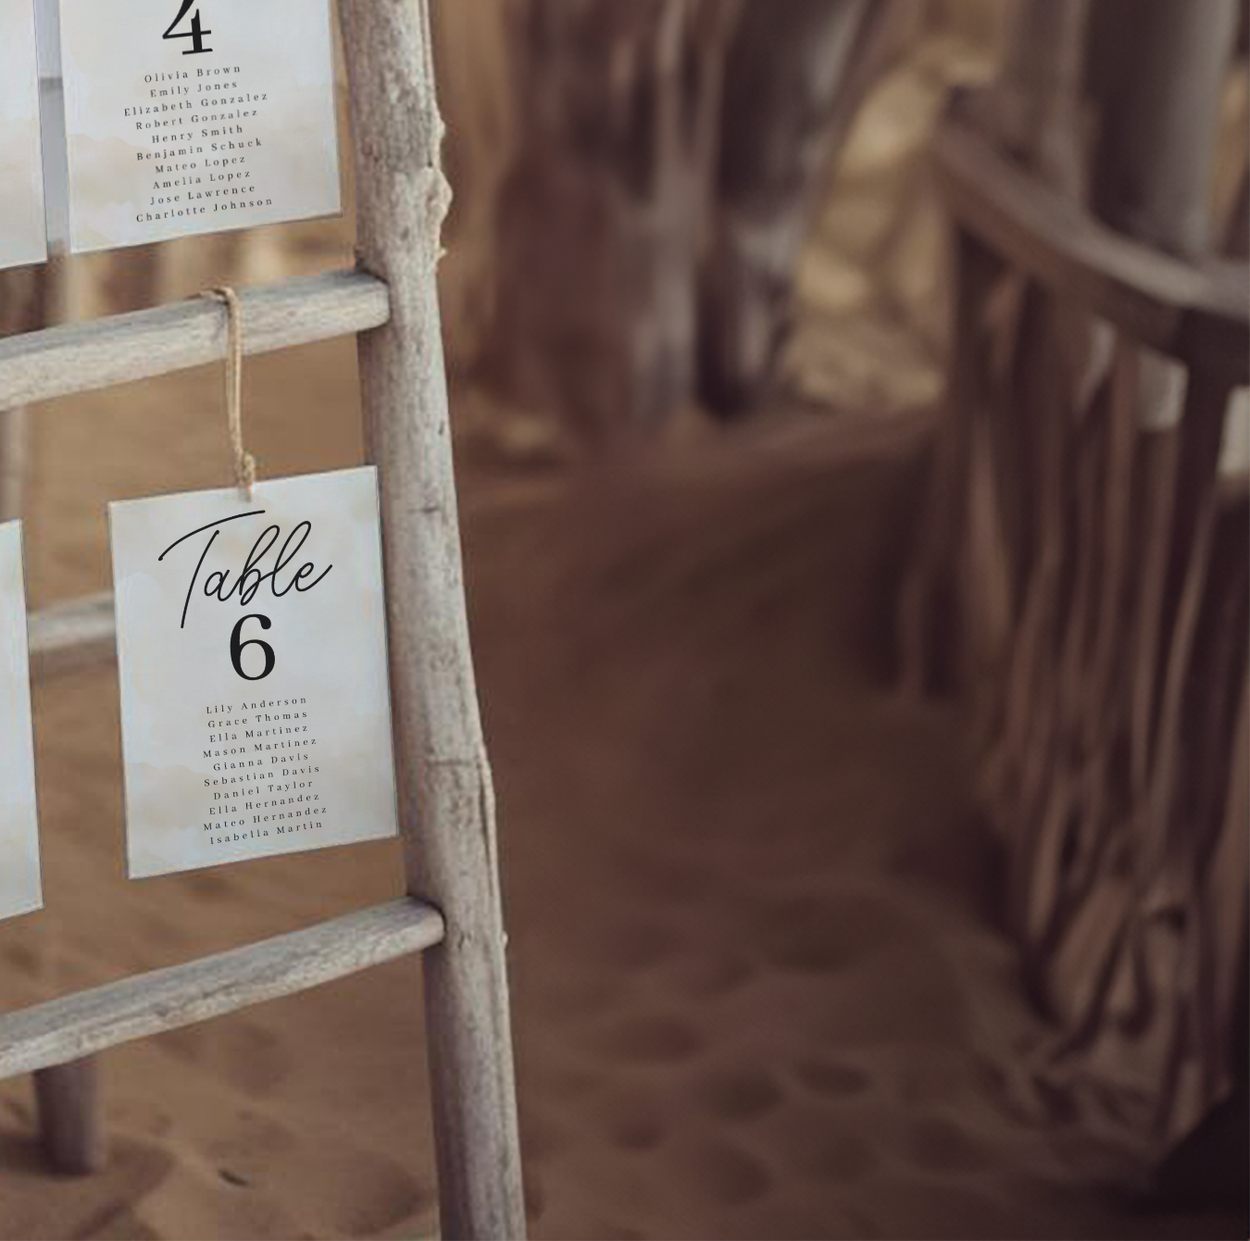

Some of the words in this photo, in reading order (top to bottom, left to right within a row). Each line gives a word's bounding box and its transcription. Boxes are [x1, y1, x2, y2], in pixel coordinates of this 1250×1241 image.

[144, 71, 188, 83] Olivia
[196, 66, 240, 77] Brown
[150, 85, 189, 98] Emily
[197, 82, 237, 92] Jones
[124, 100, 192, 117] Elizabeth
[200, 93, 267, 107] Gonzalez
[136, 117, 183, 130] Robert
[191, 109, 257, 123] Gonzalez
[152, 132, 193, 144] Henry
[201, 124, 243, 137] Smith
[136, 145, 203, 161] Benjamin
[211, 137, 262, 151] Schuck
[205, 156, 245, 168] Lopez
[153, 176, 201, 189] Amelia
[209, 171, 250, 182] Lopez
[150, 195, 180, 206] Jose
[188, 186, 255, 200] Lawrence
[136, 207, 205, 223] Charlotte
[213, 199, 272, 212] Johnson
[157, 509, 334, 629] Table
[229, 613, 277, 681] 6
[206, 704, 233, 714] Lily
[241, 698, 306, 710] Anderson
[207, 718, 248, 728] Grace
[255, 712, 307, 723] Thomas
[209, 732, 237, 743] Ella
[245, 726, 308, 738] Martinez
[203, 747, 246, 758] Mason
[254, 739, 316, 752] Martinez
[213, 759, 263, 771] Gianna
[270, 753, 308, 764] Davis
[204, 772, 274, 788] Sebastian
[282, 765, 319, 776] Davis
[213, 786, 260, 800] Daniel
[267, 781, 313, 792] Taylor
[209, 805, 237, 815] Ella
[245, 794, 319, 810] Hernandez
[252, 807, 326, 824] Hernandez
[210, 829, 269, 845] Isabella
[276, 821, 322, 835] Martin
